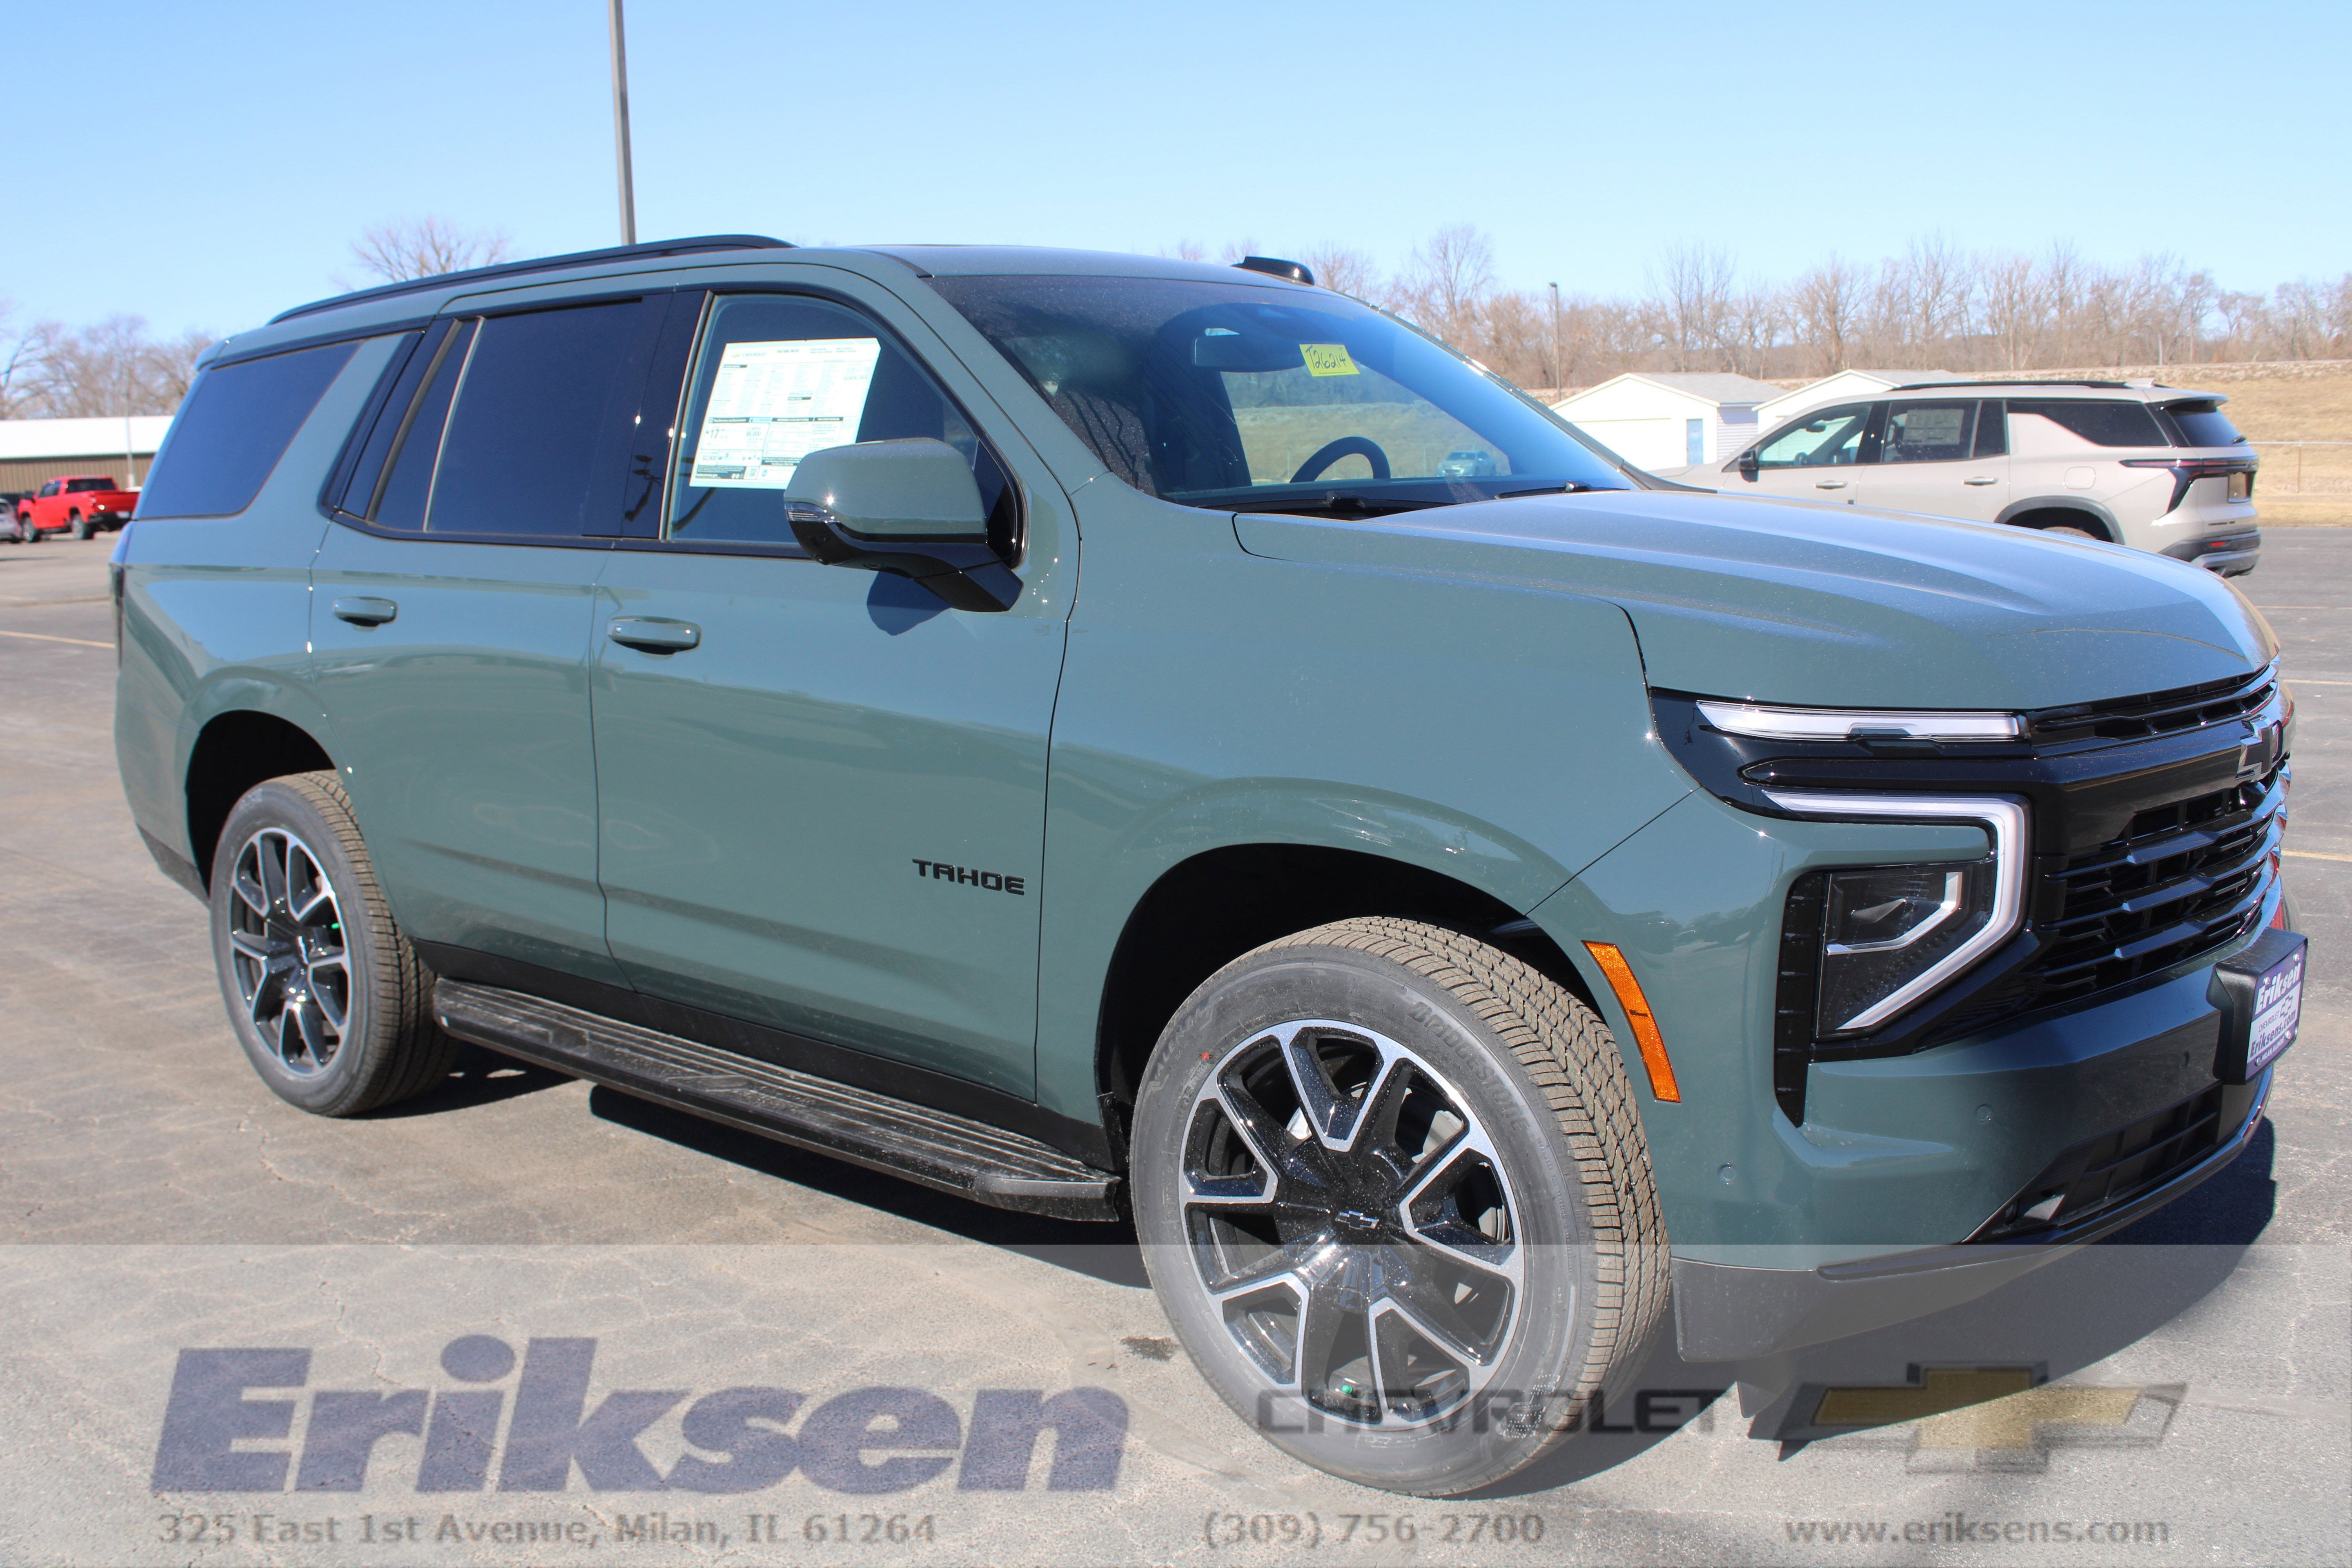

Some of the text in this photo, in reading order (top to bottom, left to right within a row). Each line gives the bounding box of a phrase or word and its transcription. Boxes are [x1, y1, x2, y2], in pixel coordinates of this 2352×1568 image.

[1305, 345, 1347, 369] T26214
[912, 858, 1025, 896] TAHOE
[2255, 962, 2301, 1015] Eriksen
[2258, 1010, 2280, 1032] CHEVROLET
